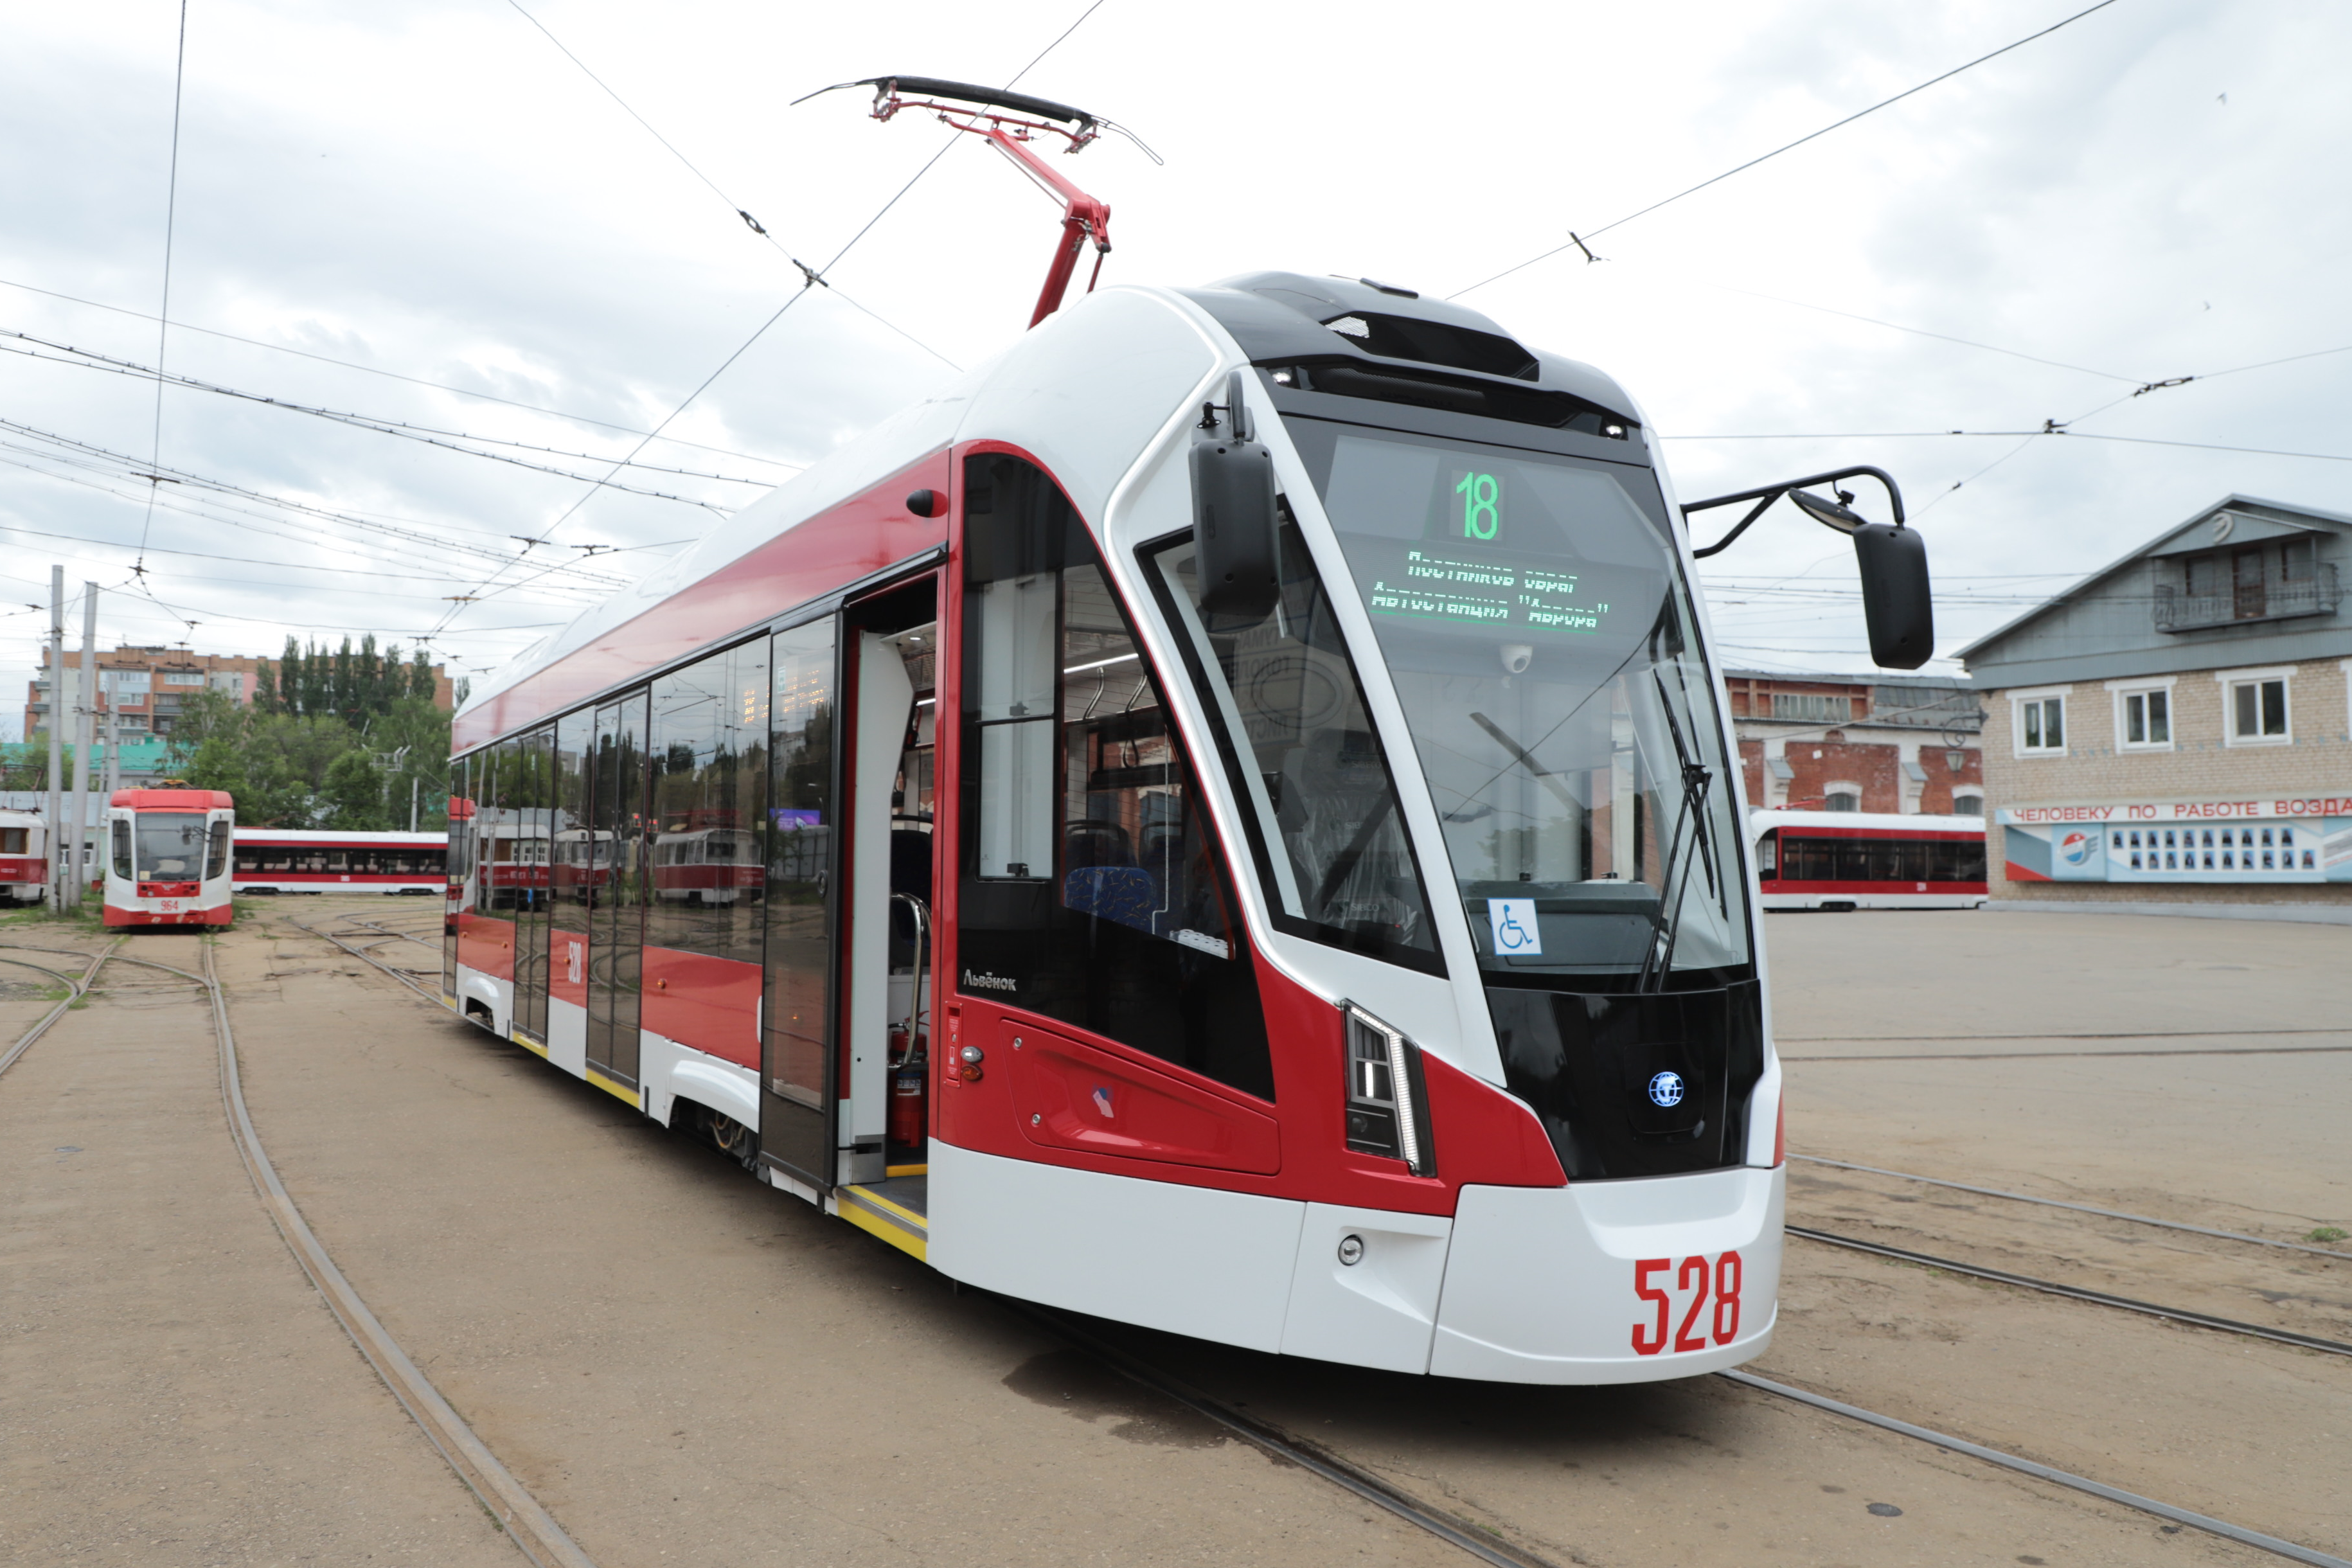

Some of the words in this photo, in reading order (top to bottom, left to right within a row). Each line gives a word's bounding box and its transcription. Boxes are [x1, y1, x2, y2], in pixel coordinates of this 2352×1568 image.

[1456, 472, 1499, 540] 18
[2014, 806, 2114, 821] ЧЕЛОВЕКУ
[2128, 805, 2157, 819] ПО
[2175, 801, 2259, 817] РАБОТЕ
[160, 900, 179, 911] 964
[568, 941, 582, 984] 528
[963, 969, 1017, 991] Львёнок
[1631, 1250, 1742, 1355] 528
